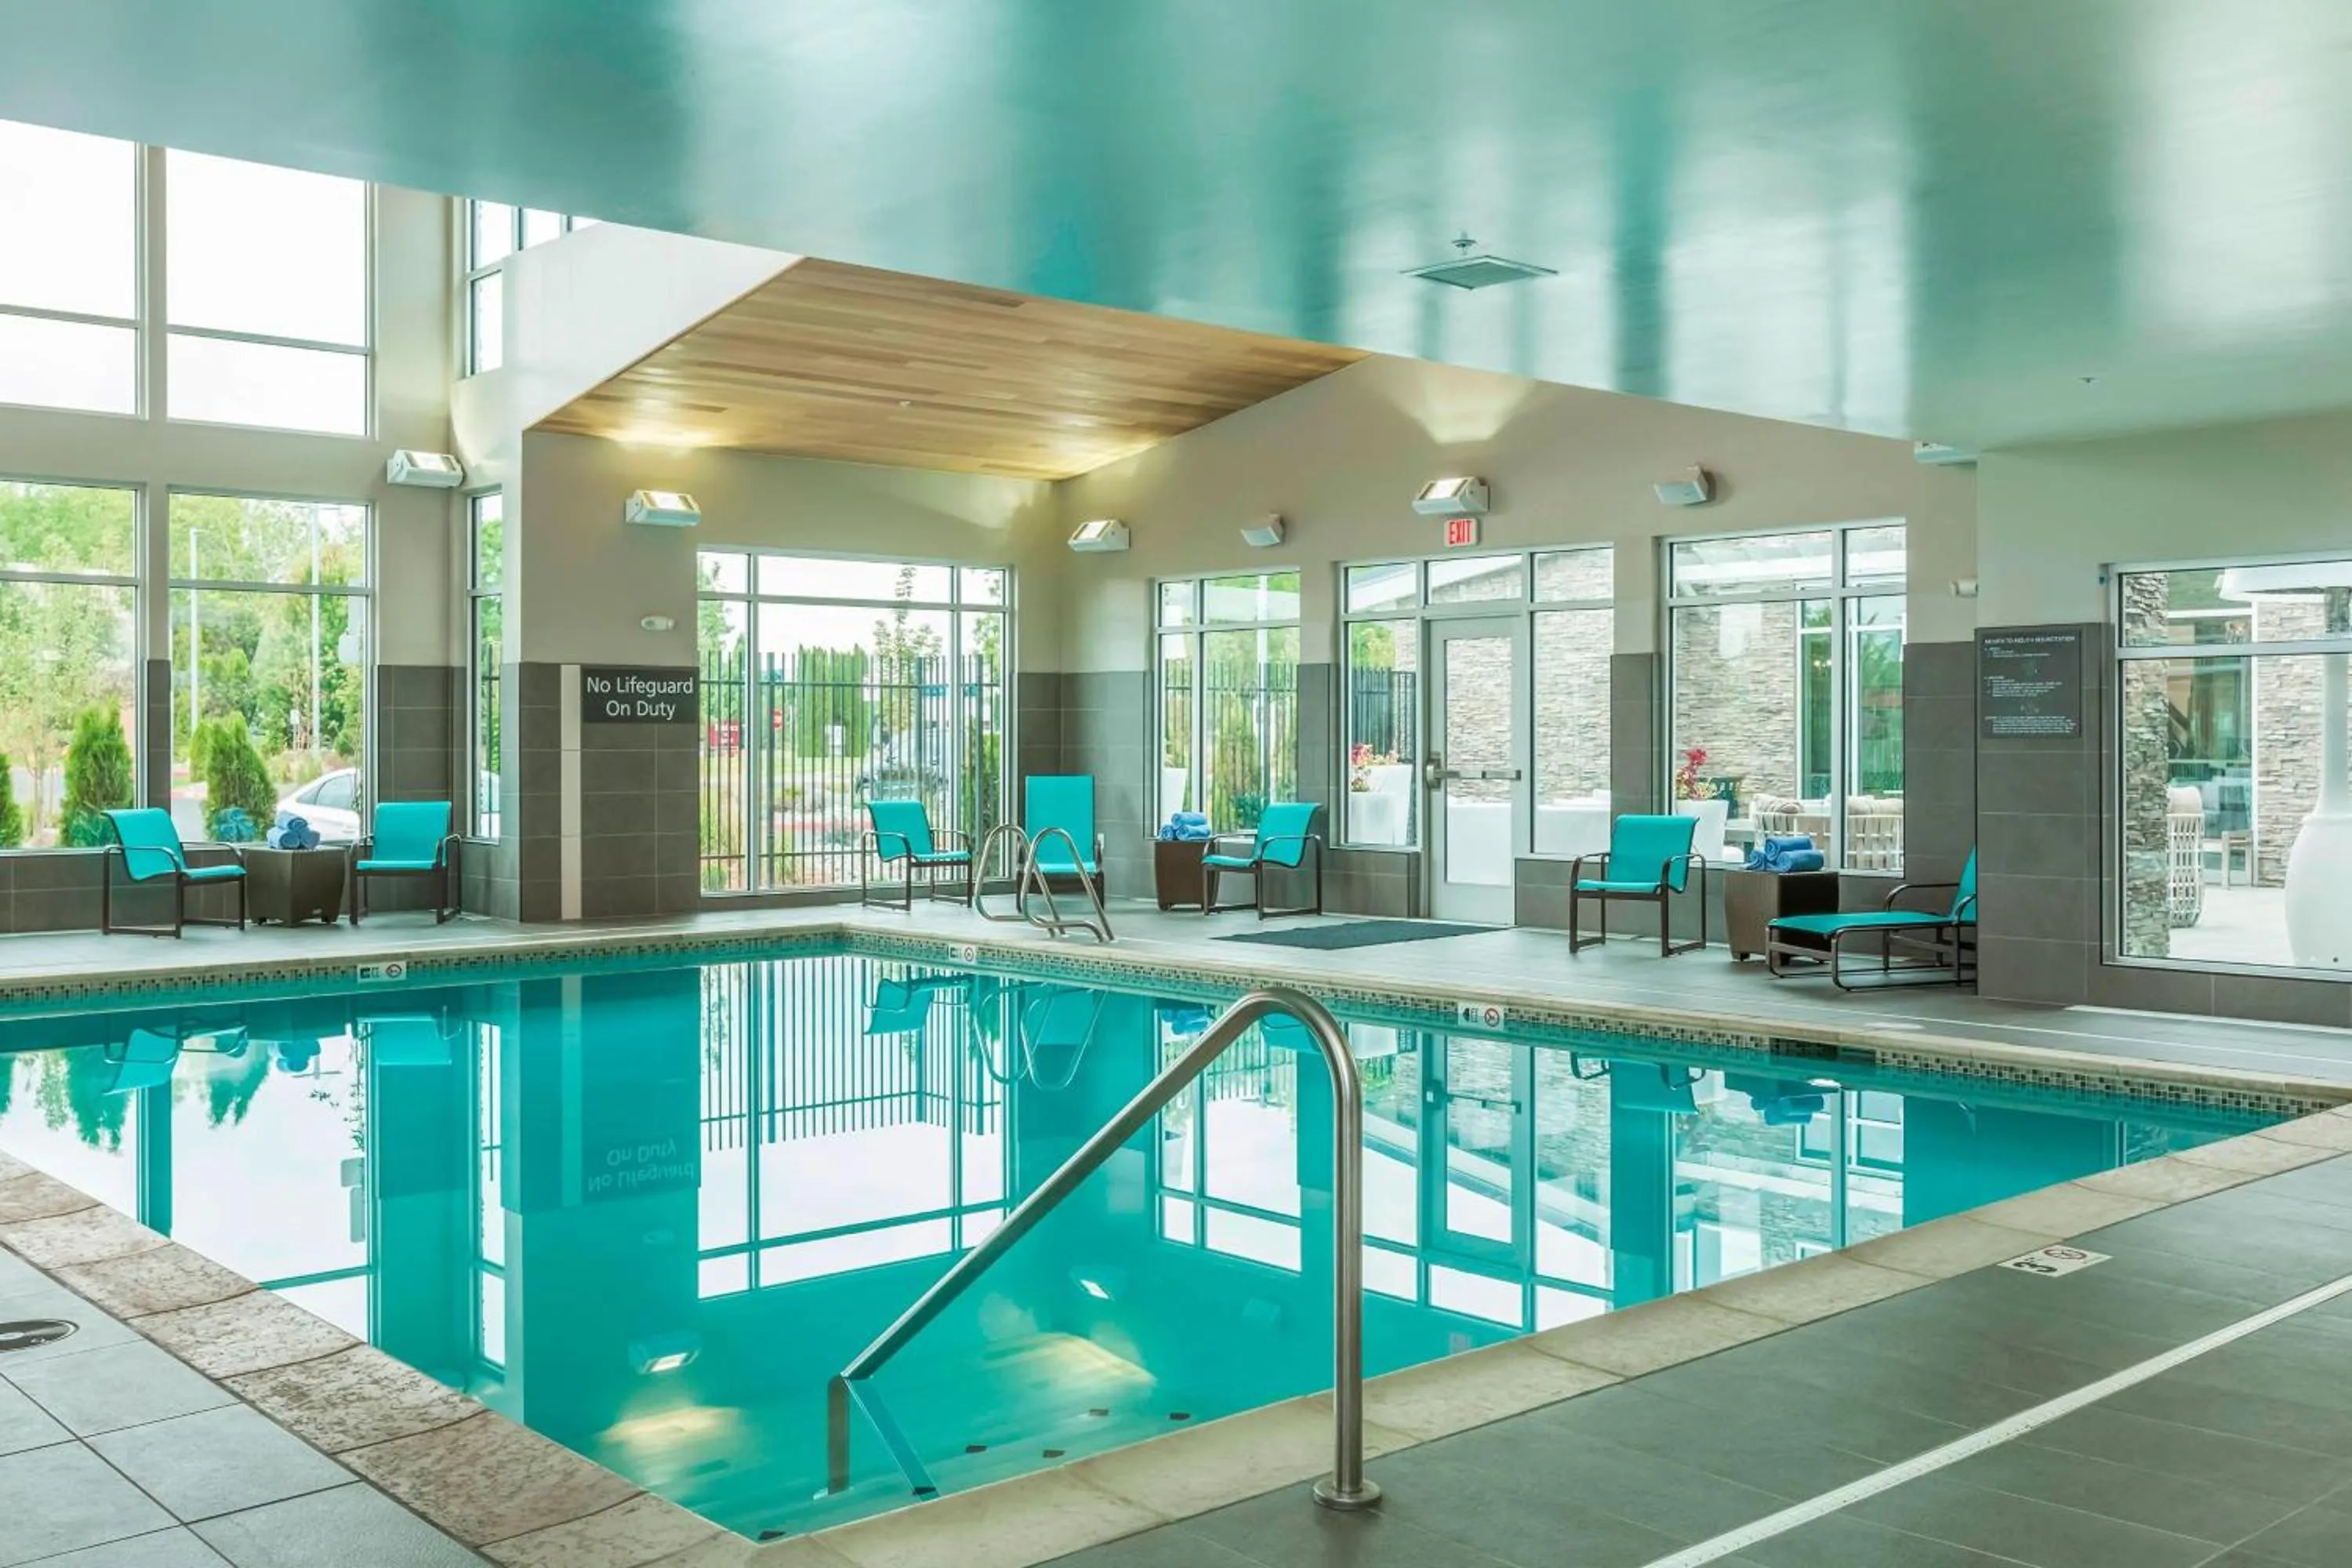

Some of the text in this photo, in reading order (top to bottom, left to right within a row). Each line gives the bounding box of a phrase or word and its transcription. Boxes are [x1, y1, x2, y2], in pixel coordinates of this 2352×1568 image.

[1449, 520, 1472, 544] EXIT
[587, 676, 694, 698] No Lifeguard
[606, 700, 676, 720] On Duty
